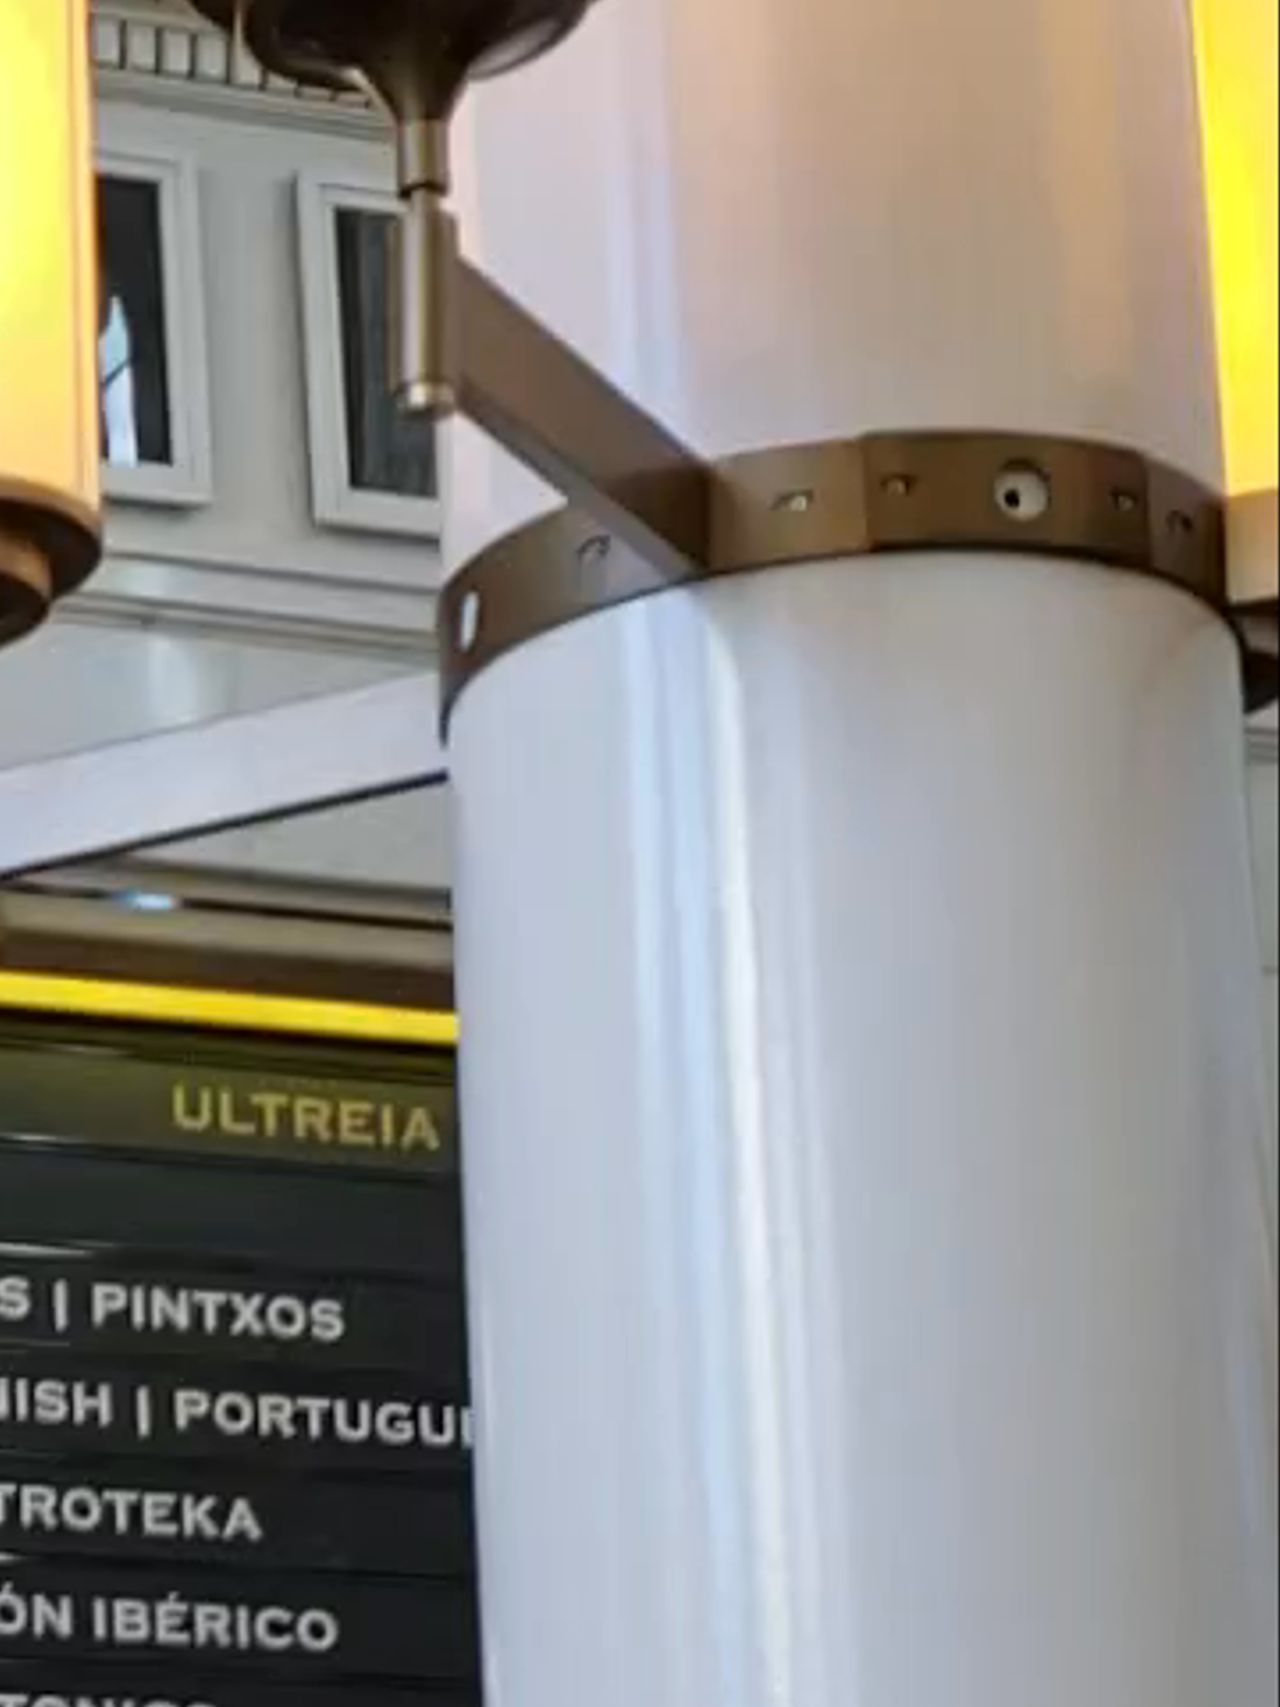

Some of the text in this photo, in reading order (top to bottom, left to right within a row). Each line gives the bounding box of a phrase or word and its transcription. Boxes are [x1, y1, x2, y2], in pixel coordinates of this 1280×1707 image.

[172, 1084, 440, 1150] ULTREIA
[93, 1284, 344, 1340] PINTXOS
[94, 1593, 337, 1650] IBÉRICO
